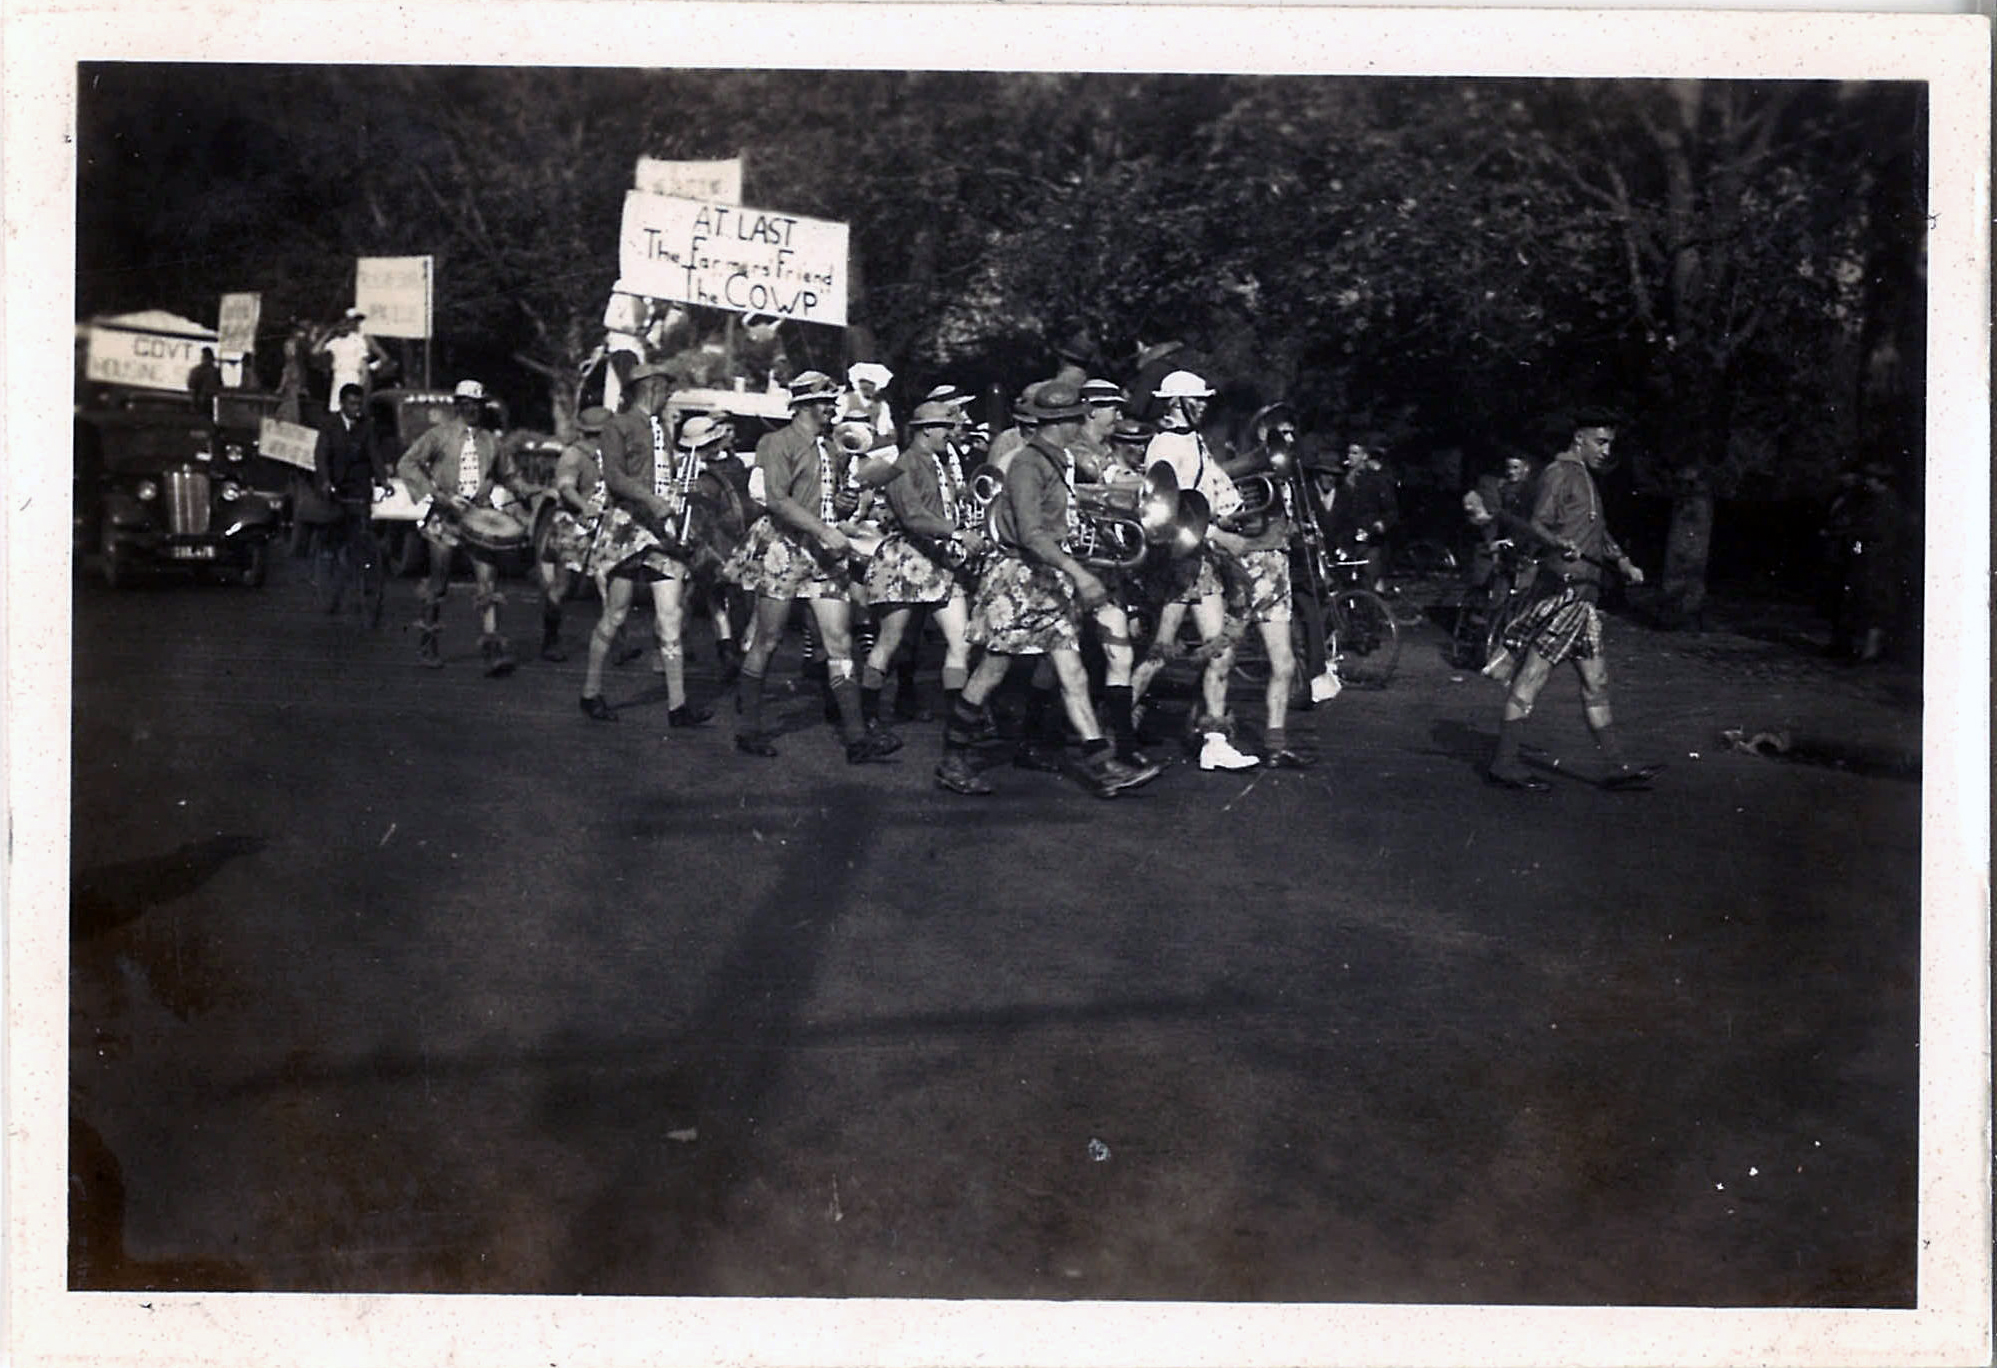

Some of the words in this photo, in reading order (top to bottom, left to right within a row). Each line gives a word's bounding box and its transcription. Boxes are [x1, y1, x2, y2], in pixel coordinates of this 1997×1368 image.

[643, 228, 680, 262] The
[692, 206, 729, 236] AT
[737, 214, 798, 247] LAST
[681, 264, 718, 304] The
